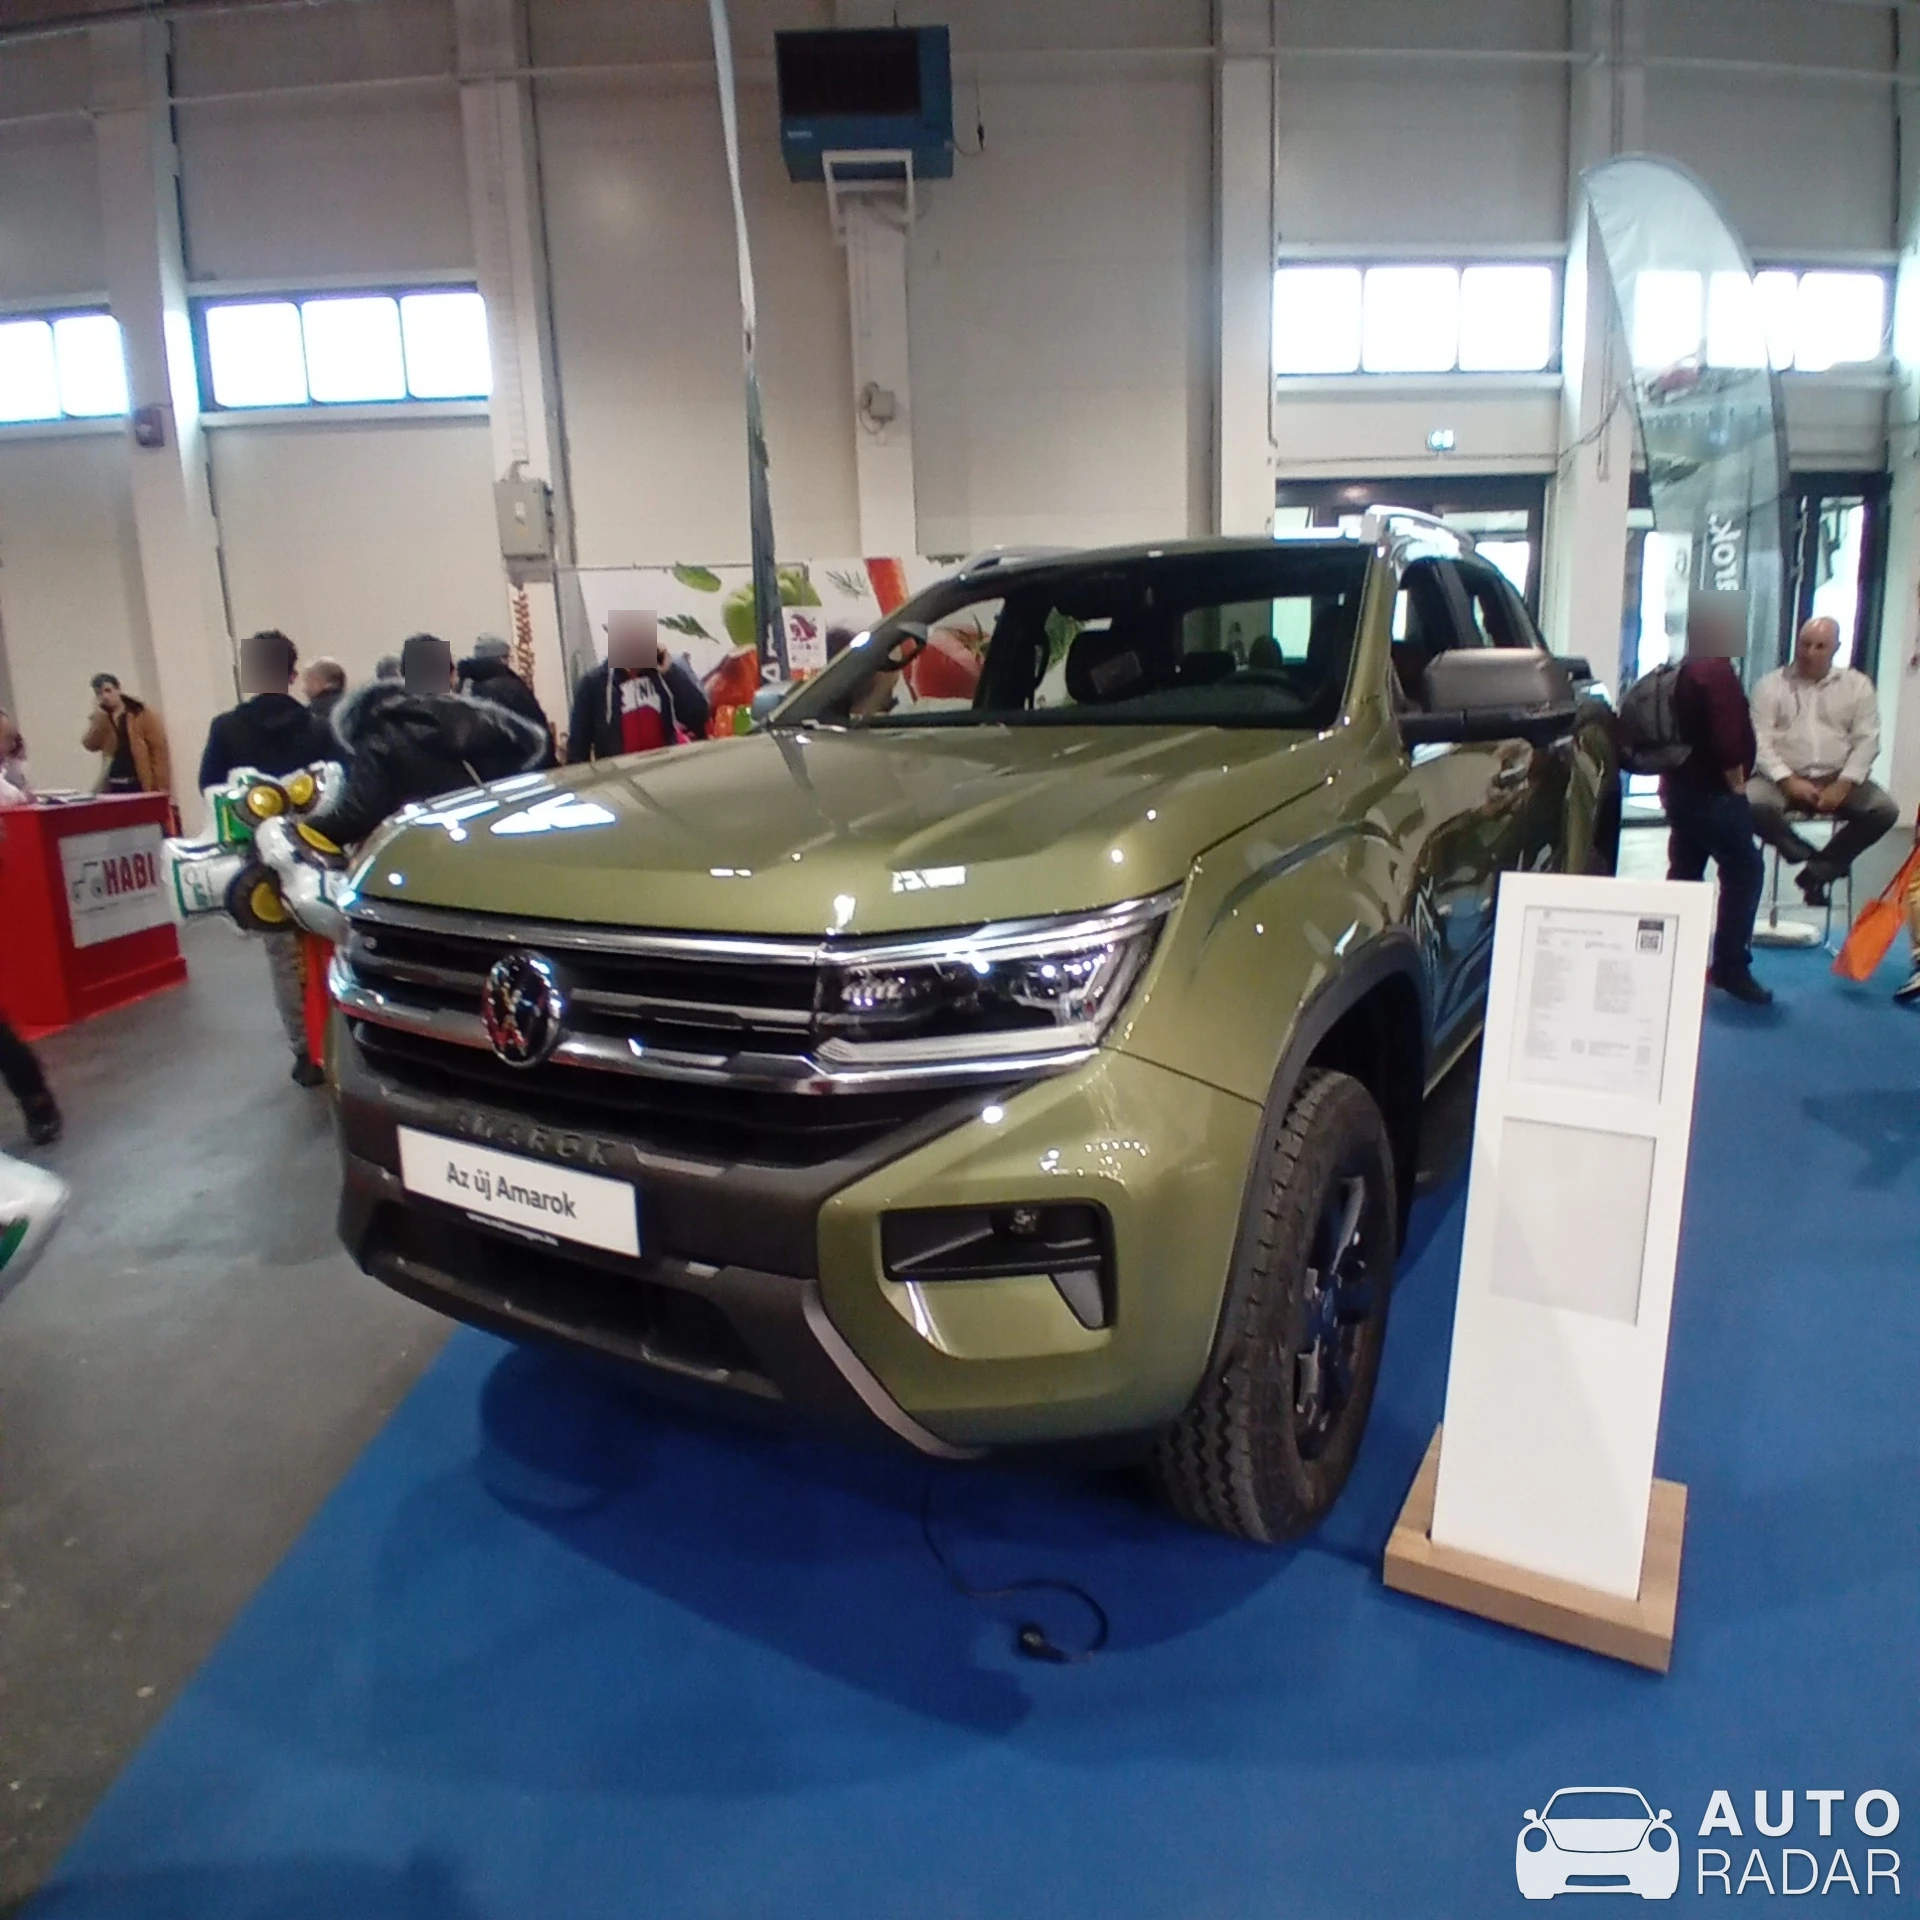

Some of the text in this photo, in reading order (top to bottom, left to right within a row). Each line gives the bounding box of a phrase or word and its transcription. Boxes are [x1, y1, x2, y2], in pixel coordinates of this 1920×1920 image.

[447, 1160, 577, 1219] Az új Amarok
